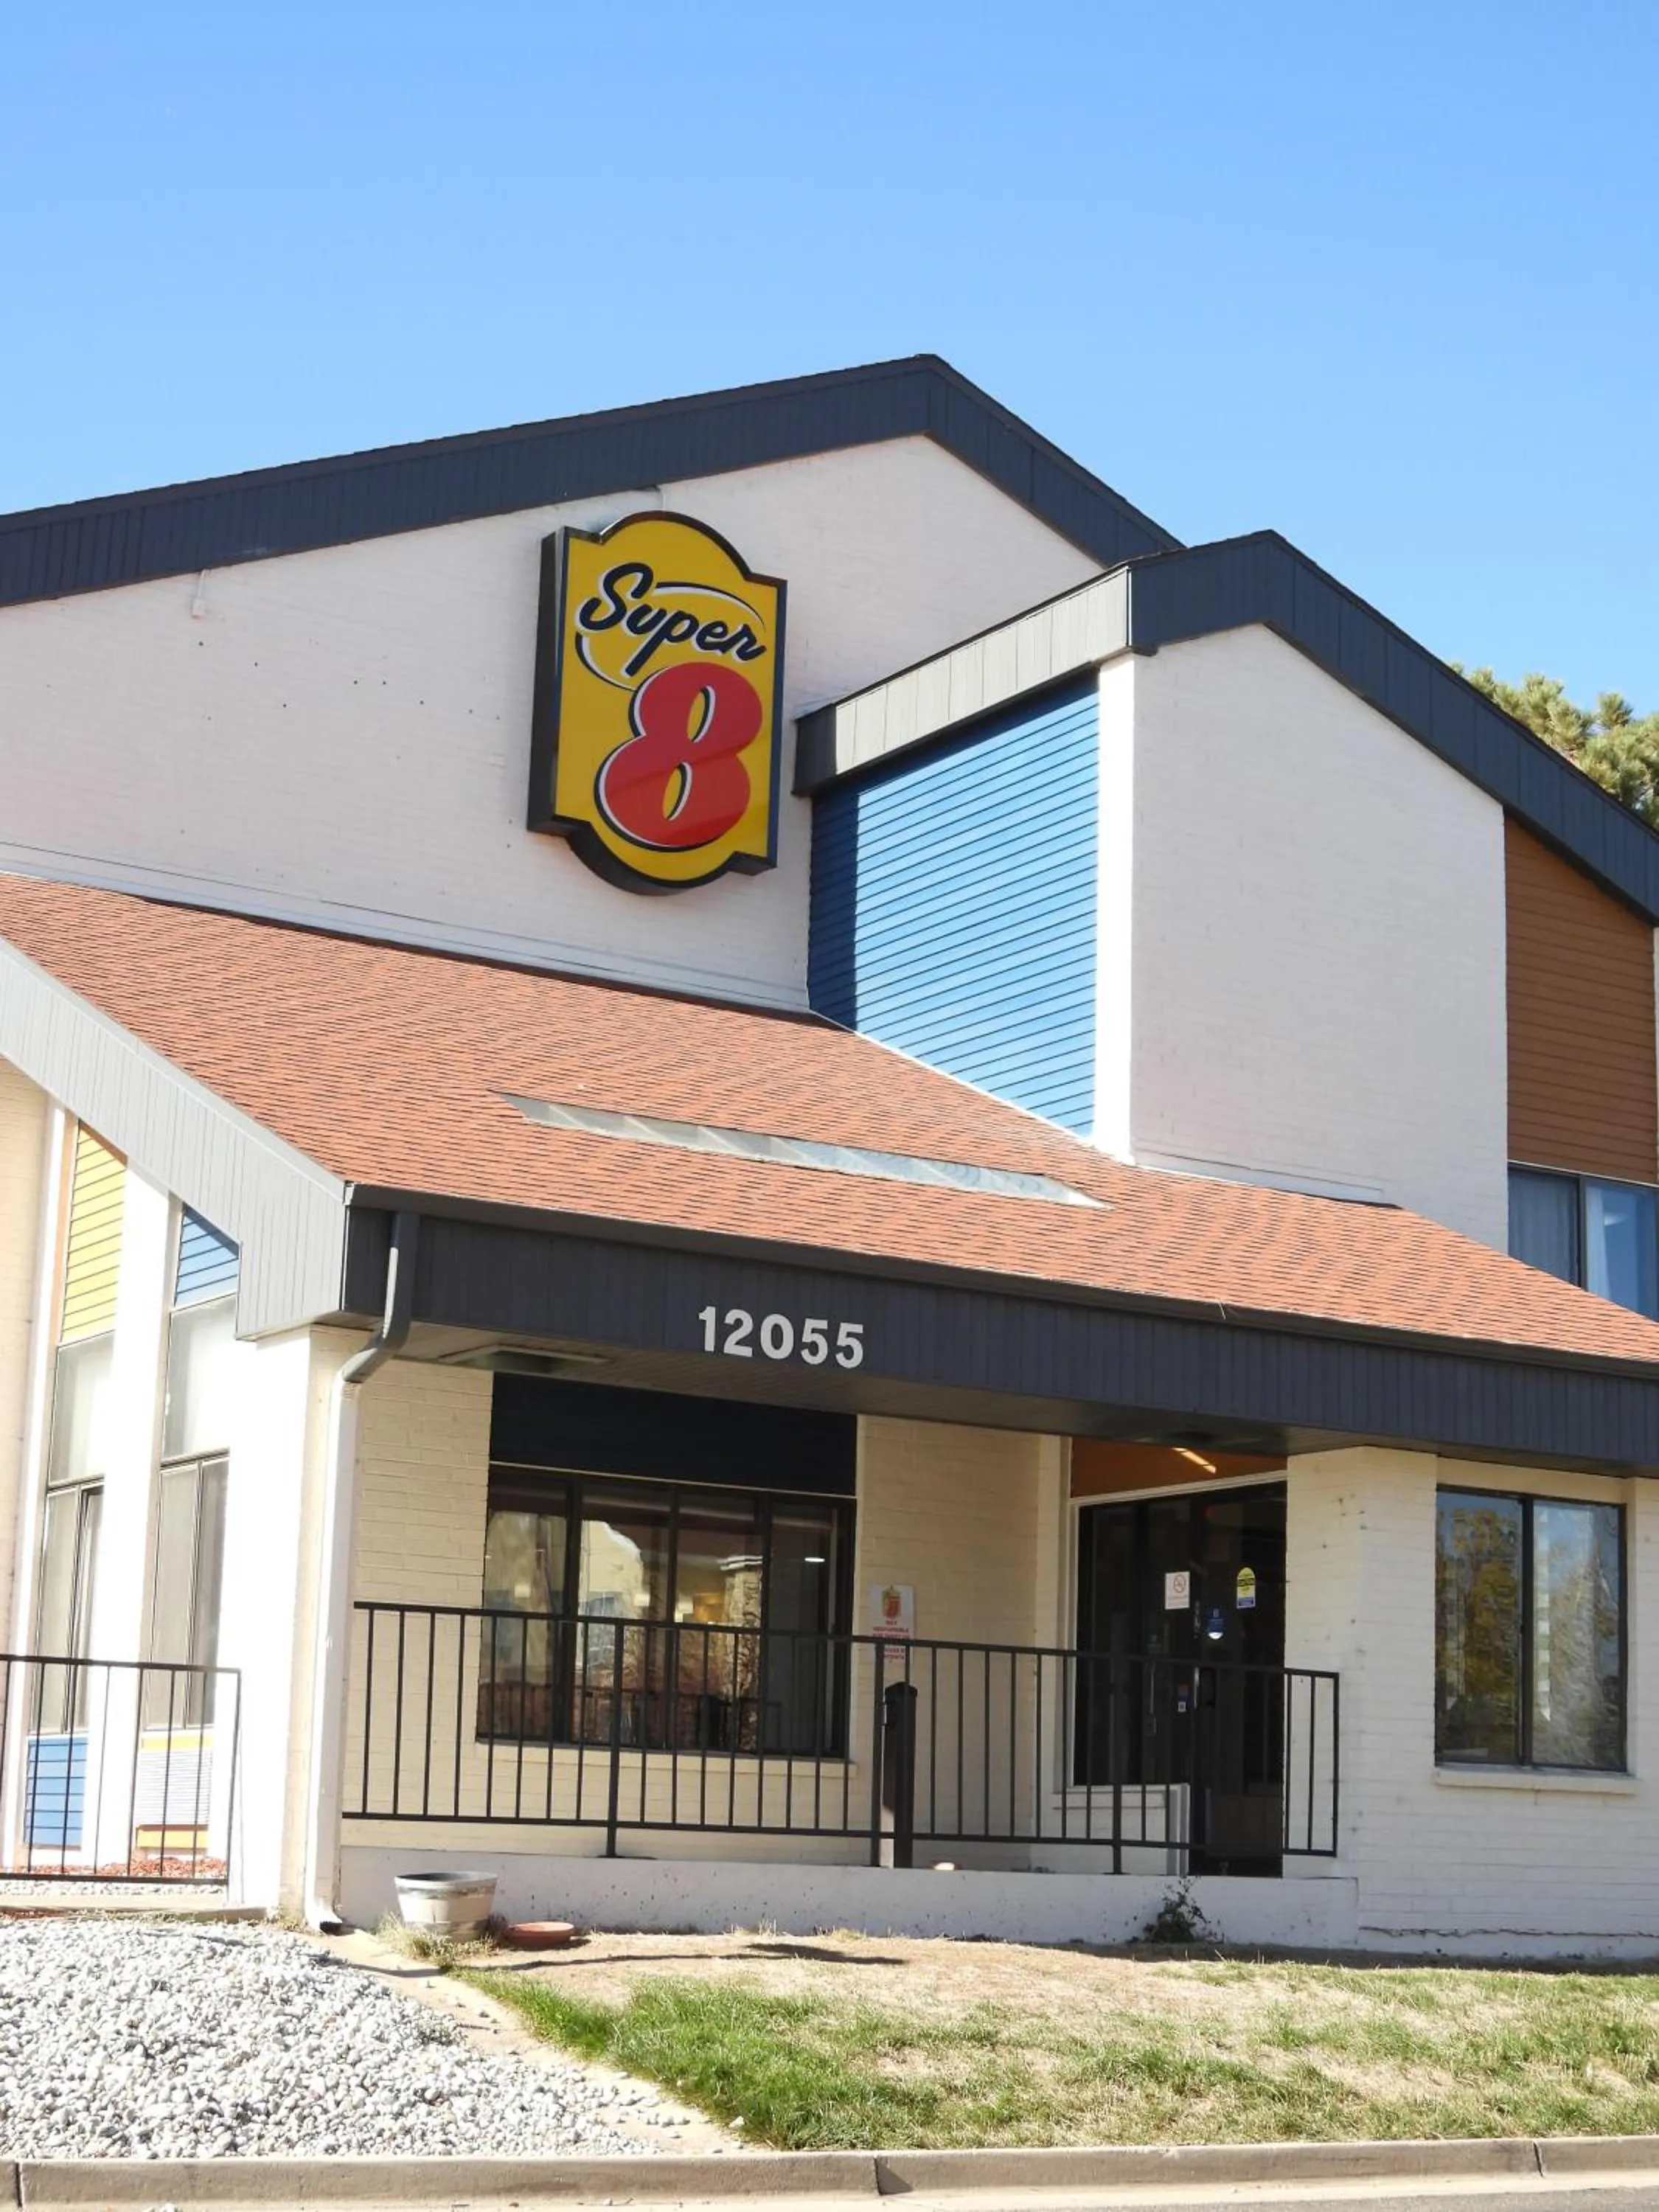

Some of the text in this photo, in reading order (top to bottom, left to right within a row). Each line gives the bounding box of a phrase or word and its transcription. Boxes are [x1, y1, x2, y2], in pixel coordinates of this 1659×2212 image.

[578, 562, 767, 677] Super
[594, 661, 763, 852] 8
[698, 1306, 863, 1368] 12055
